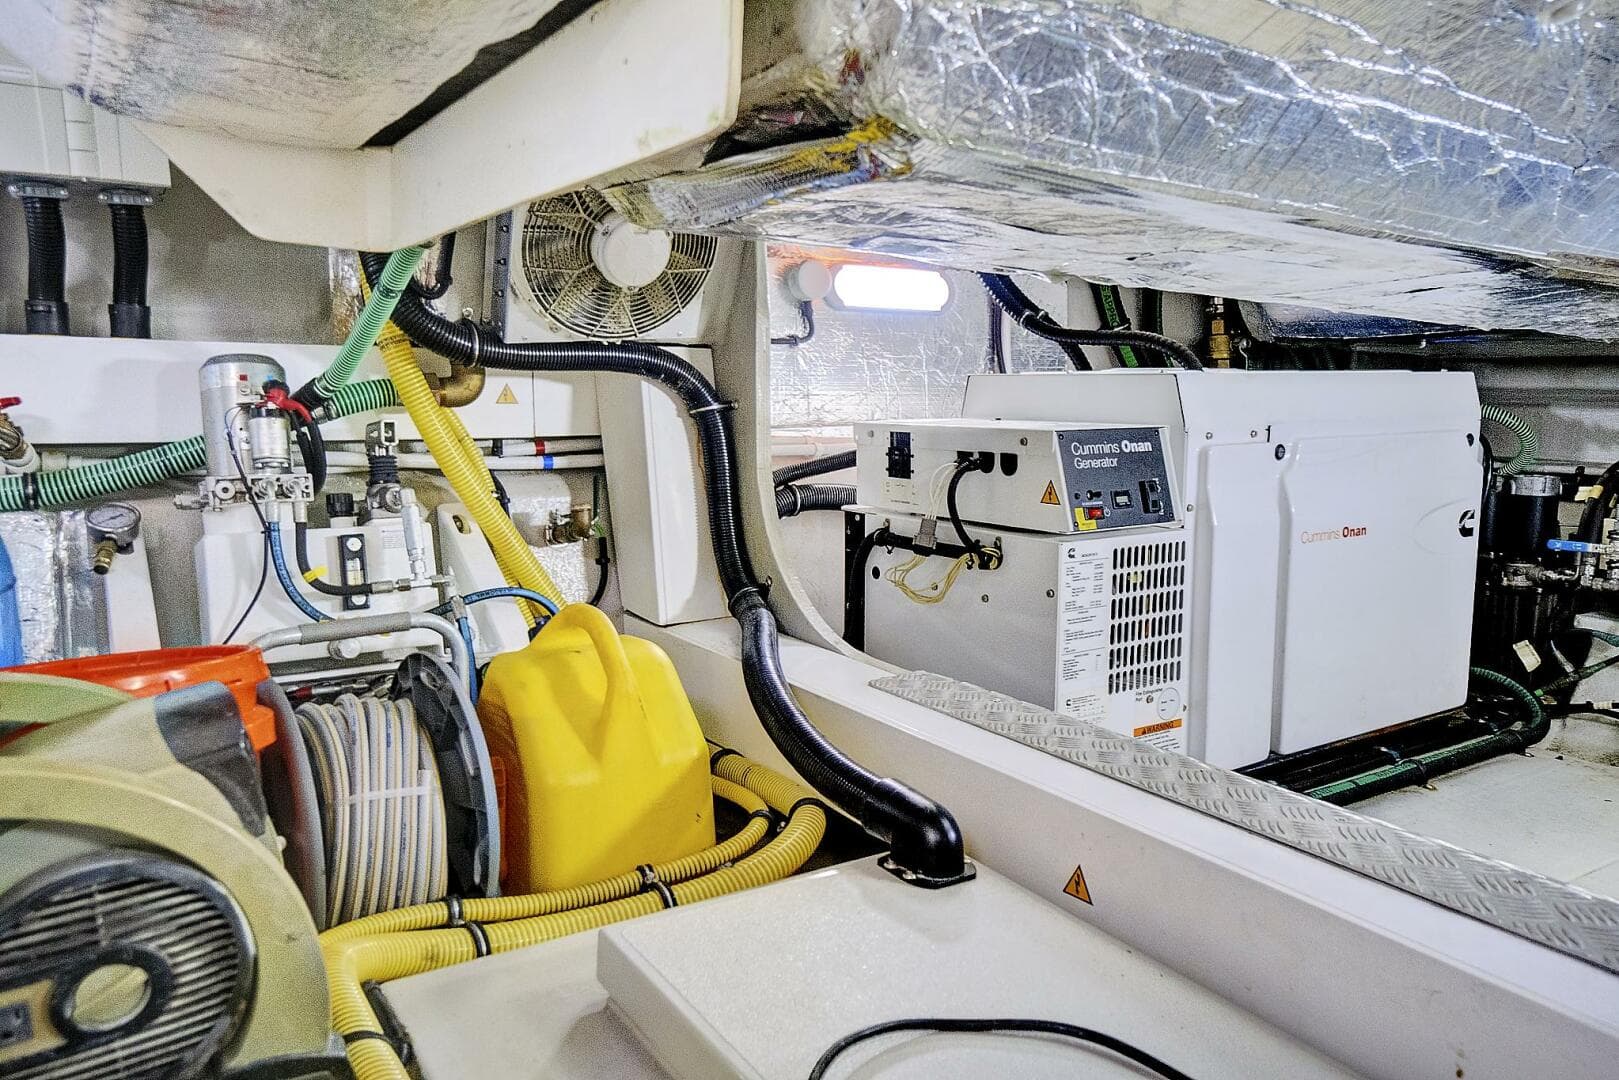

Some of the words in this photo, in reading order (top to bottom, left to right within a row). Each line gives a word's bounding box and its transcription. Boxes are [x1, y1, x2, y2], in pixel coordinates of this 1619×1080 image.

[1071, 441, 1120, 456] Cummins
[1121, 439, 1153, 453] Onan
[1074, 457, 1118, 469] Generator
[1301, 529, 1341, 544] Cummins
[1342, 526, 1367, 538] Onan
